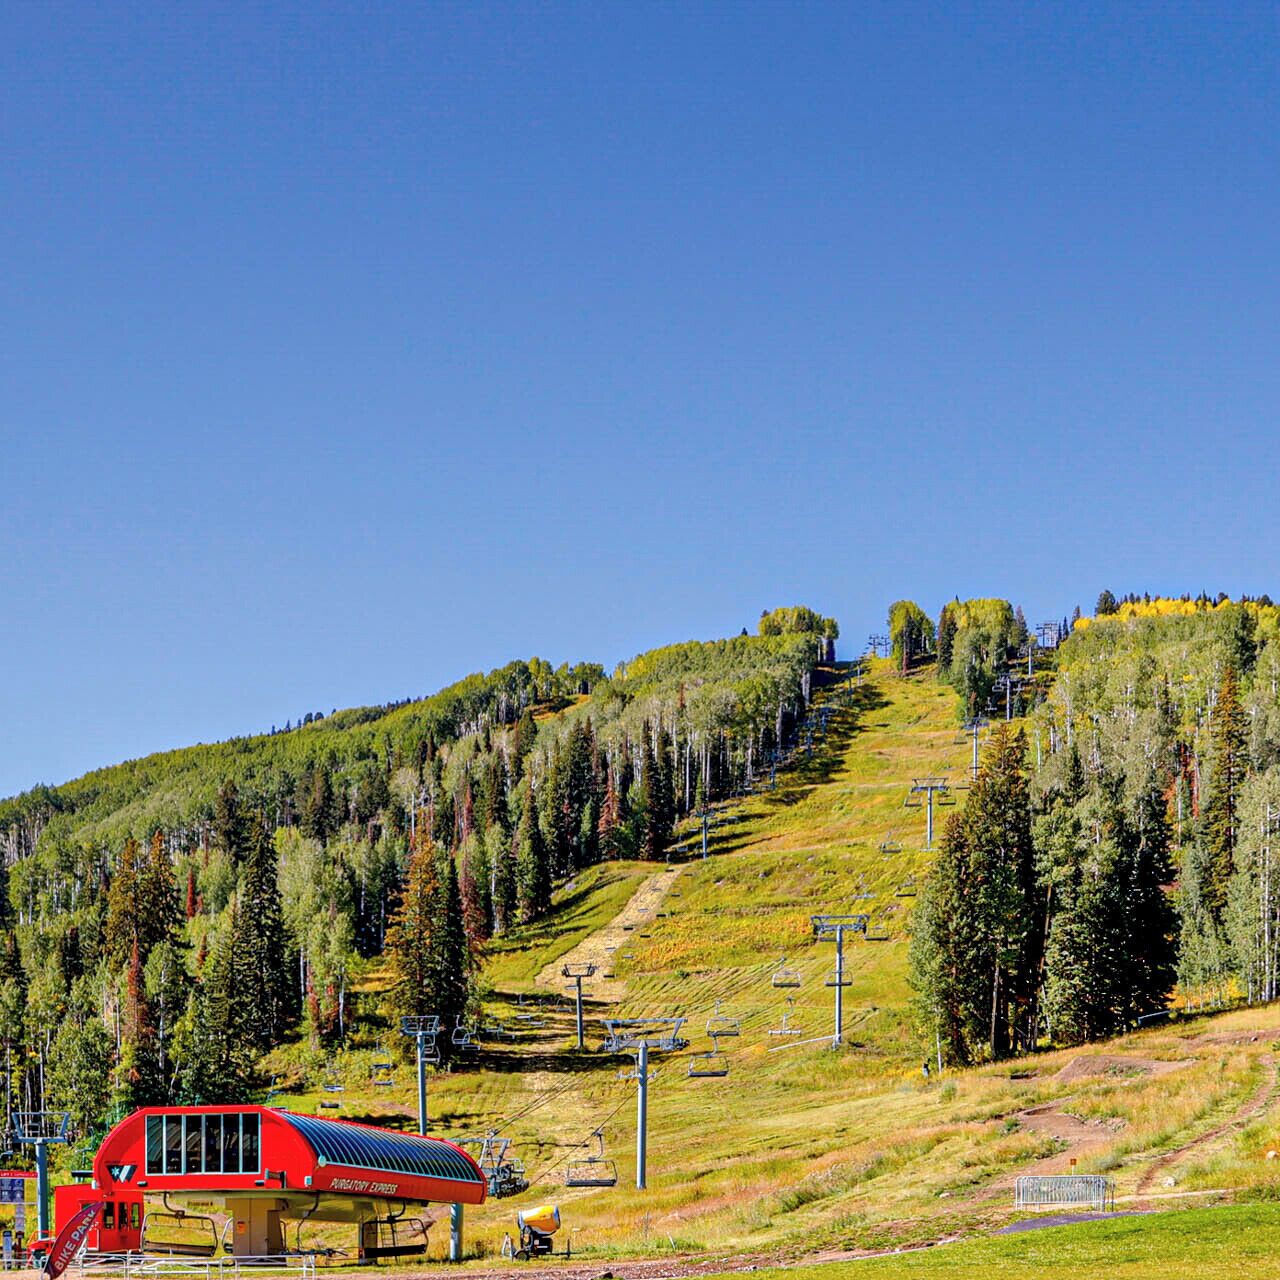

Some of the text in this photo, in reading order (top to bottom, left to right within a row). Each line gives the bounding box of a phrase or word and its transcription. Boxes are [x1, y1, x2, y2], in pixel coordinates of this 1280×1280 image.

[329, 1178, 398, 1194] PURGATORY EXPRESS
[54, 1210, 96, 1271] BIKE PARK
